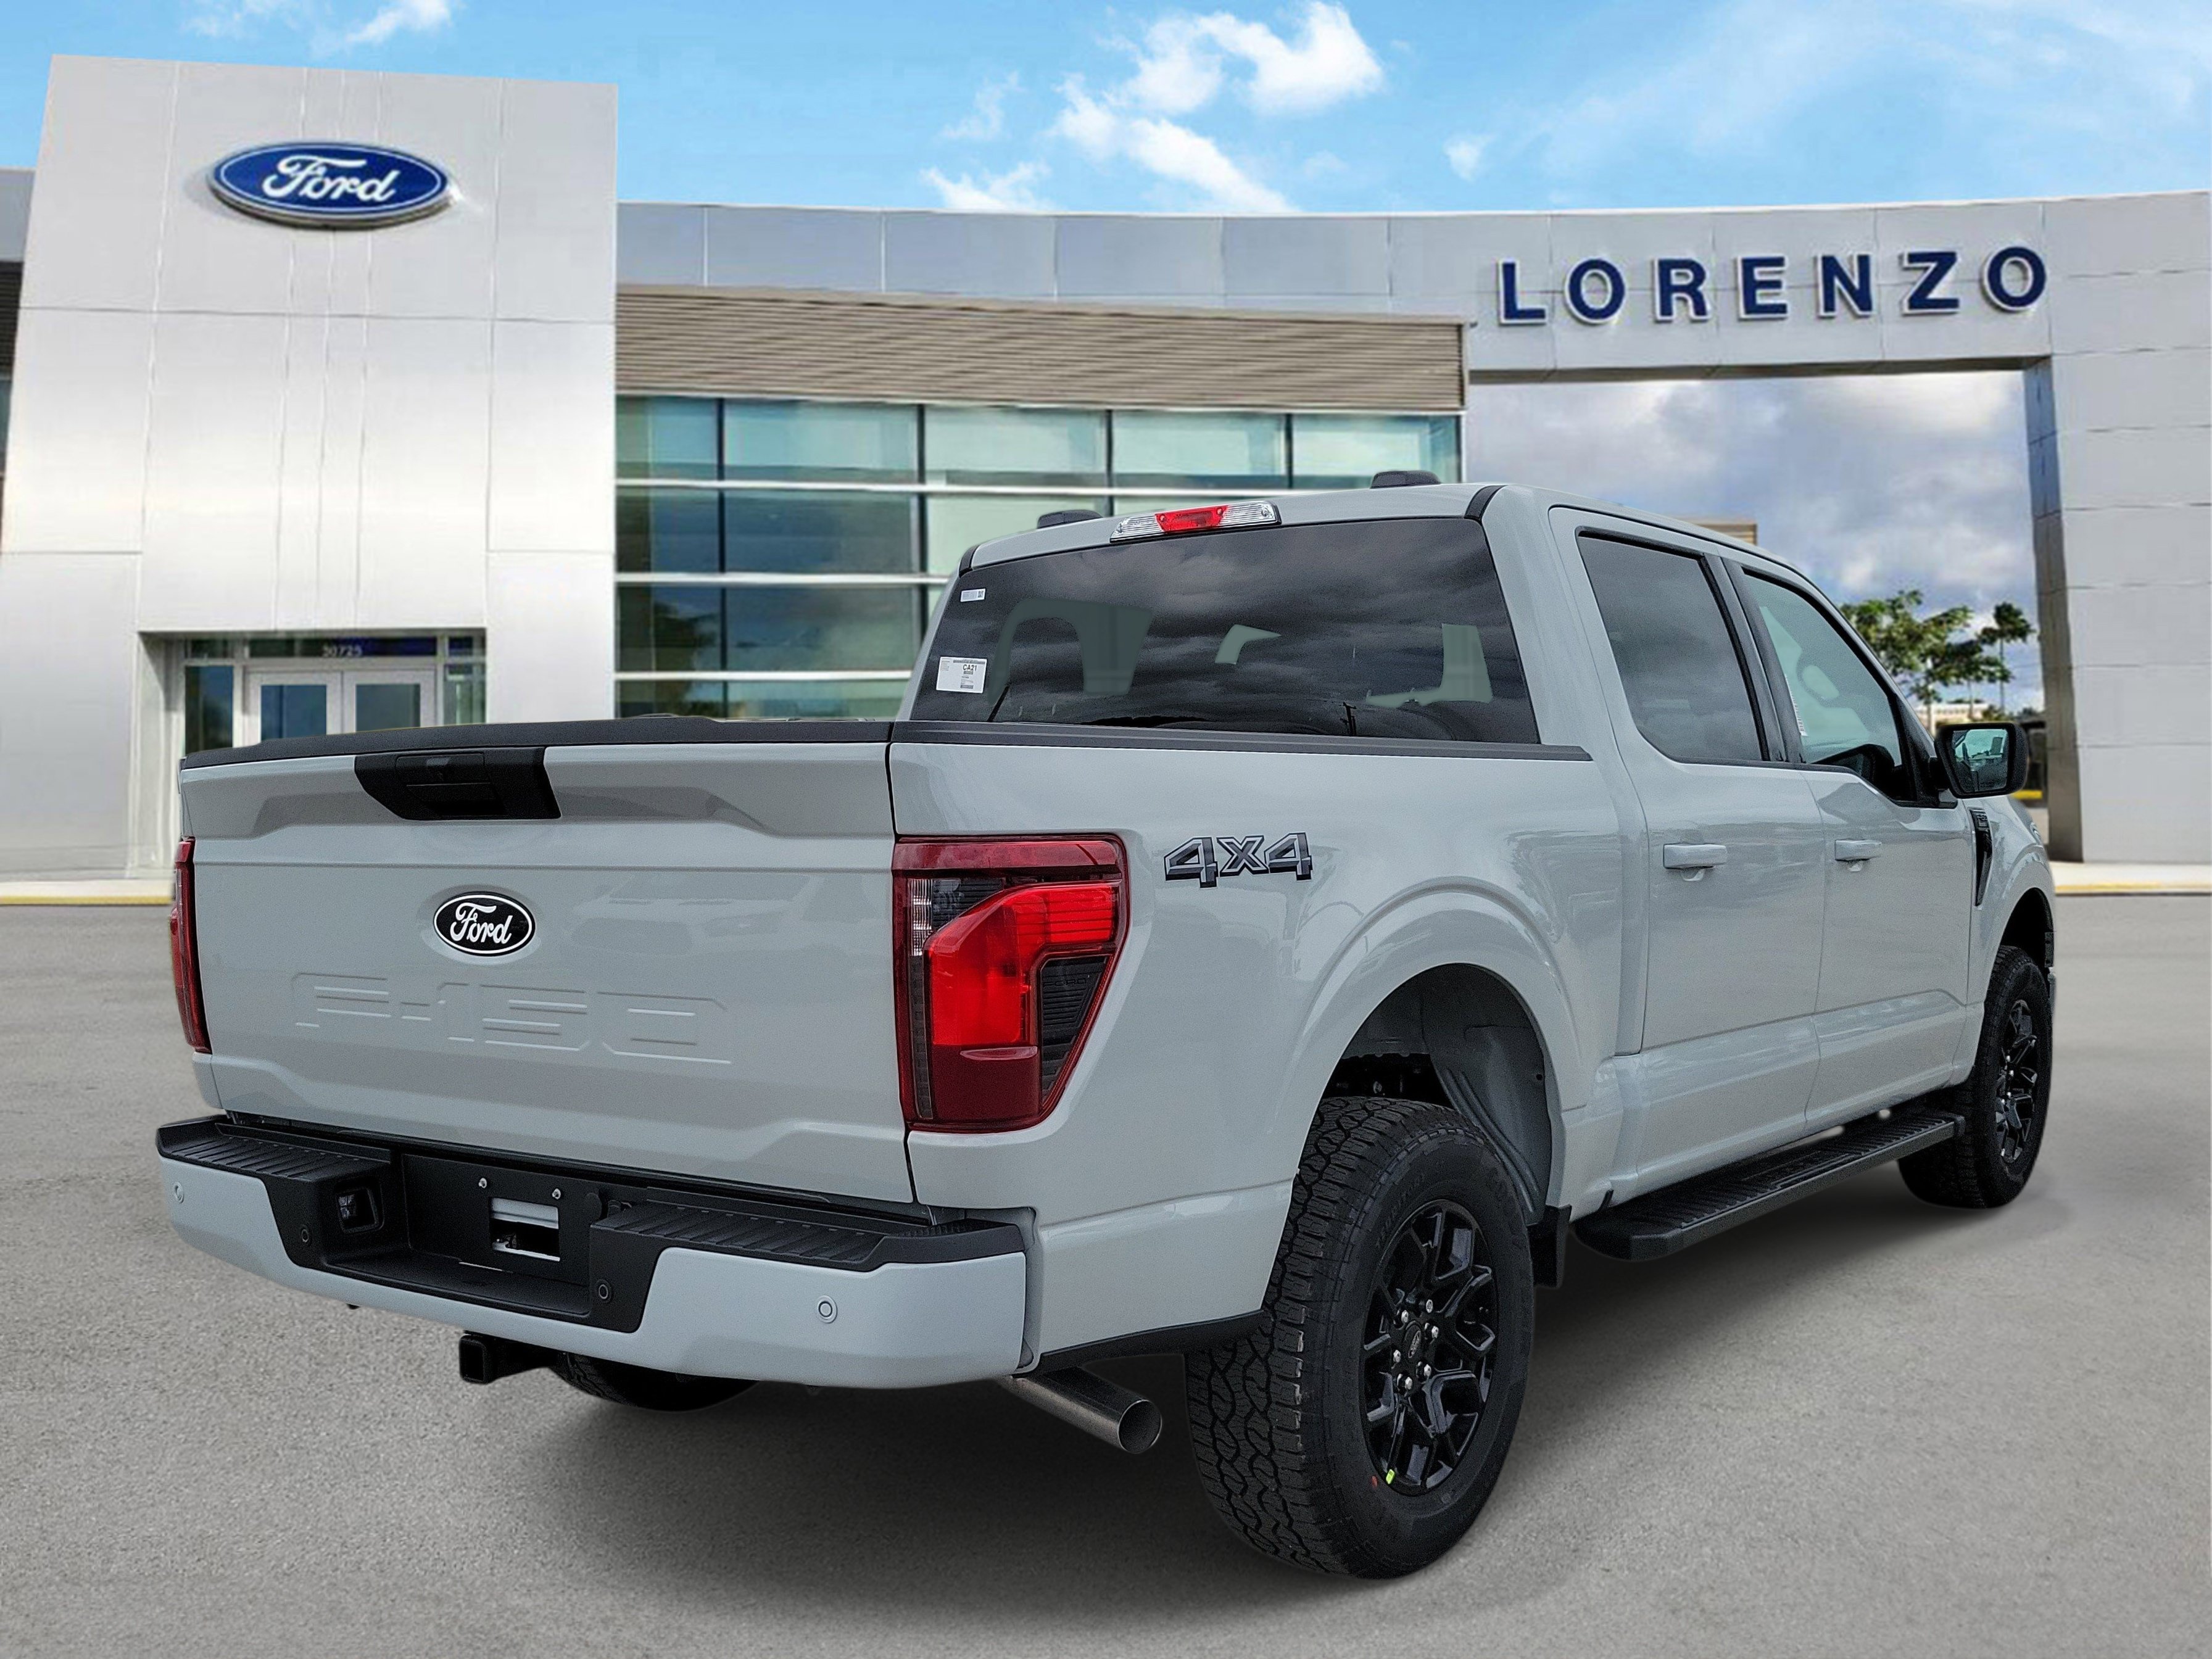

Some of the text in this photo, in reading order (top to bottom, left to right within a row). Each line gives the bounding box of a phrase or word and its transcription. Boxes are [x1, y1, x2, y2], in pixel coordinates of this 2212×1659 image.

[262, 155, 400, 202] Ford
[1495, 246, 2048, 327] LORENZO
[963, 664, 977, 672] CA21
[450, 902, 513, 945] Ford
